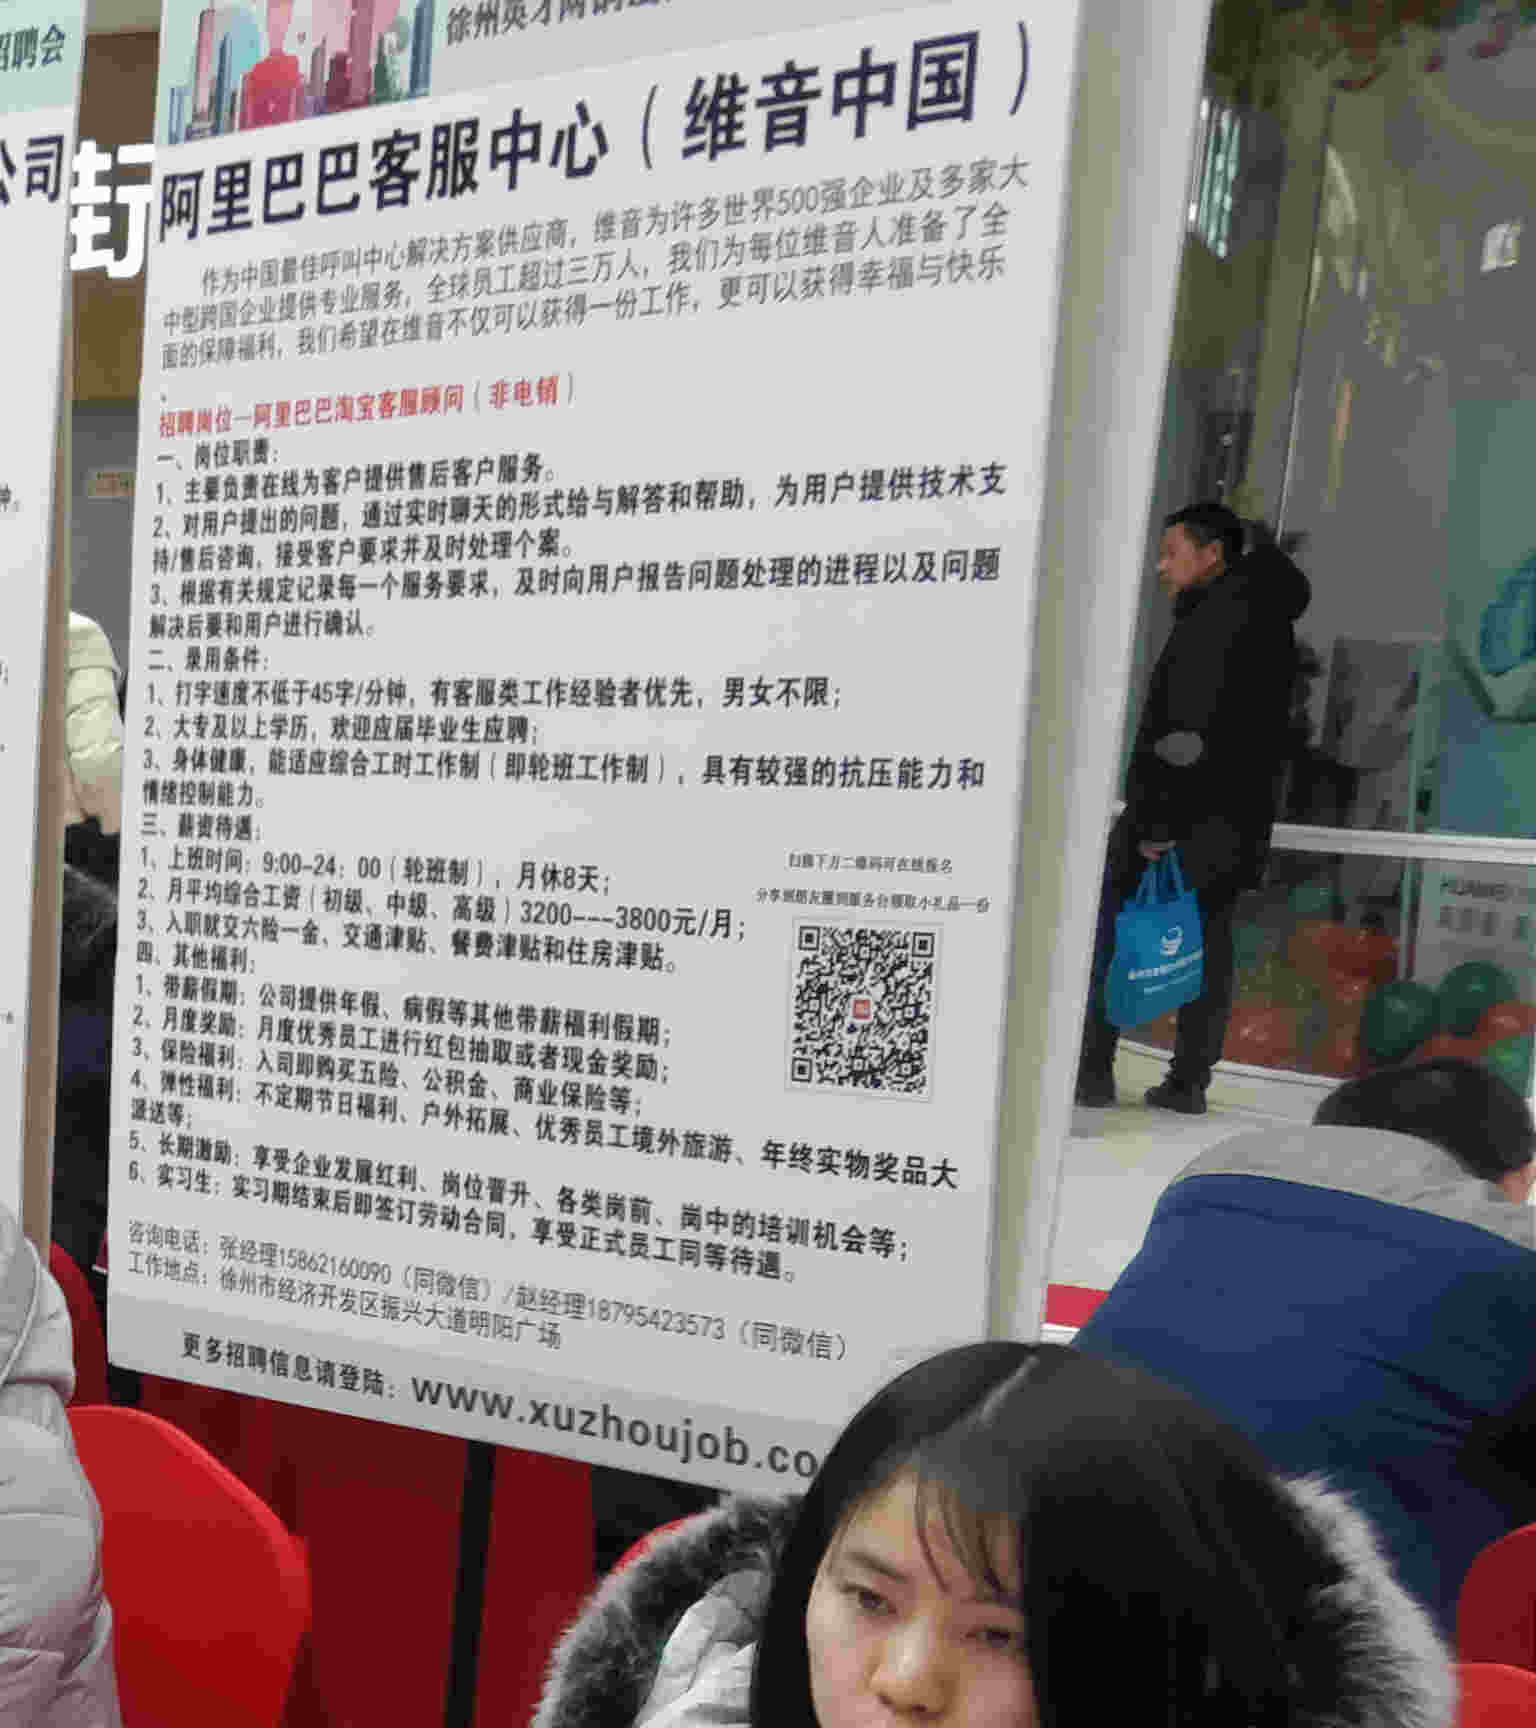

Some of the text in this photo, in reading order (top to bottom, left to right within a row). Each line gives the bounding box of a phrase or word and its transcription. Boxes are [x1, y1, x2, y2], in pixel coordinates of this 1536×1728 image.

[159, 20, 1033, 242] 阿里巴巴客服中心（维音中国）
